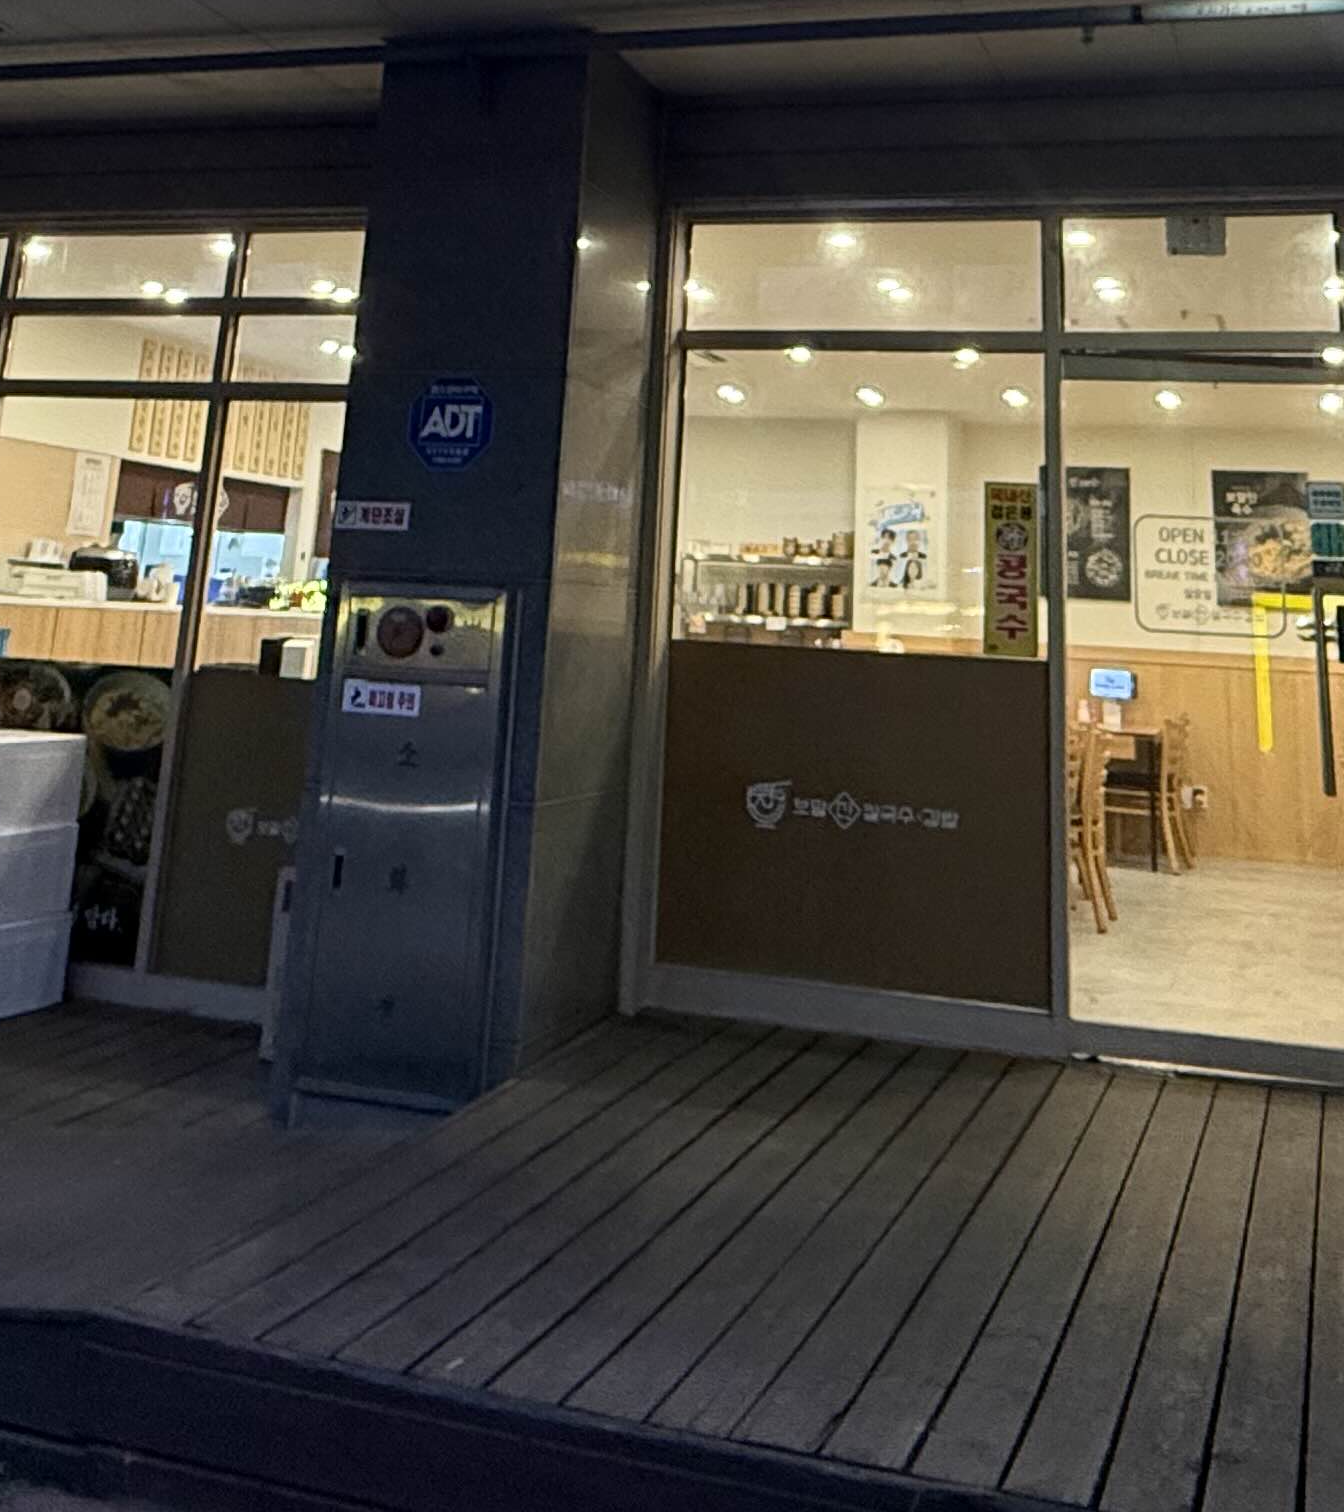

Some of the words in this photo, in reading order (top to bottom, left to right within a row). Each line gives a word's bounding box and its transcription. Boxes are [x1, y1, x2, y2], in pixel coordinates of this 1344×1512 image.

[419, 404, 483, 439] ADT
[1159, 527, 1204, 543] OPEN
[1155, 548, 1209, 565] CLOSE
[1144, 570, 1180, 581] BREAK
